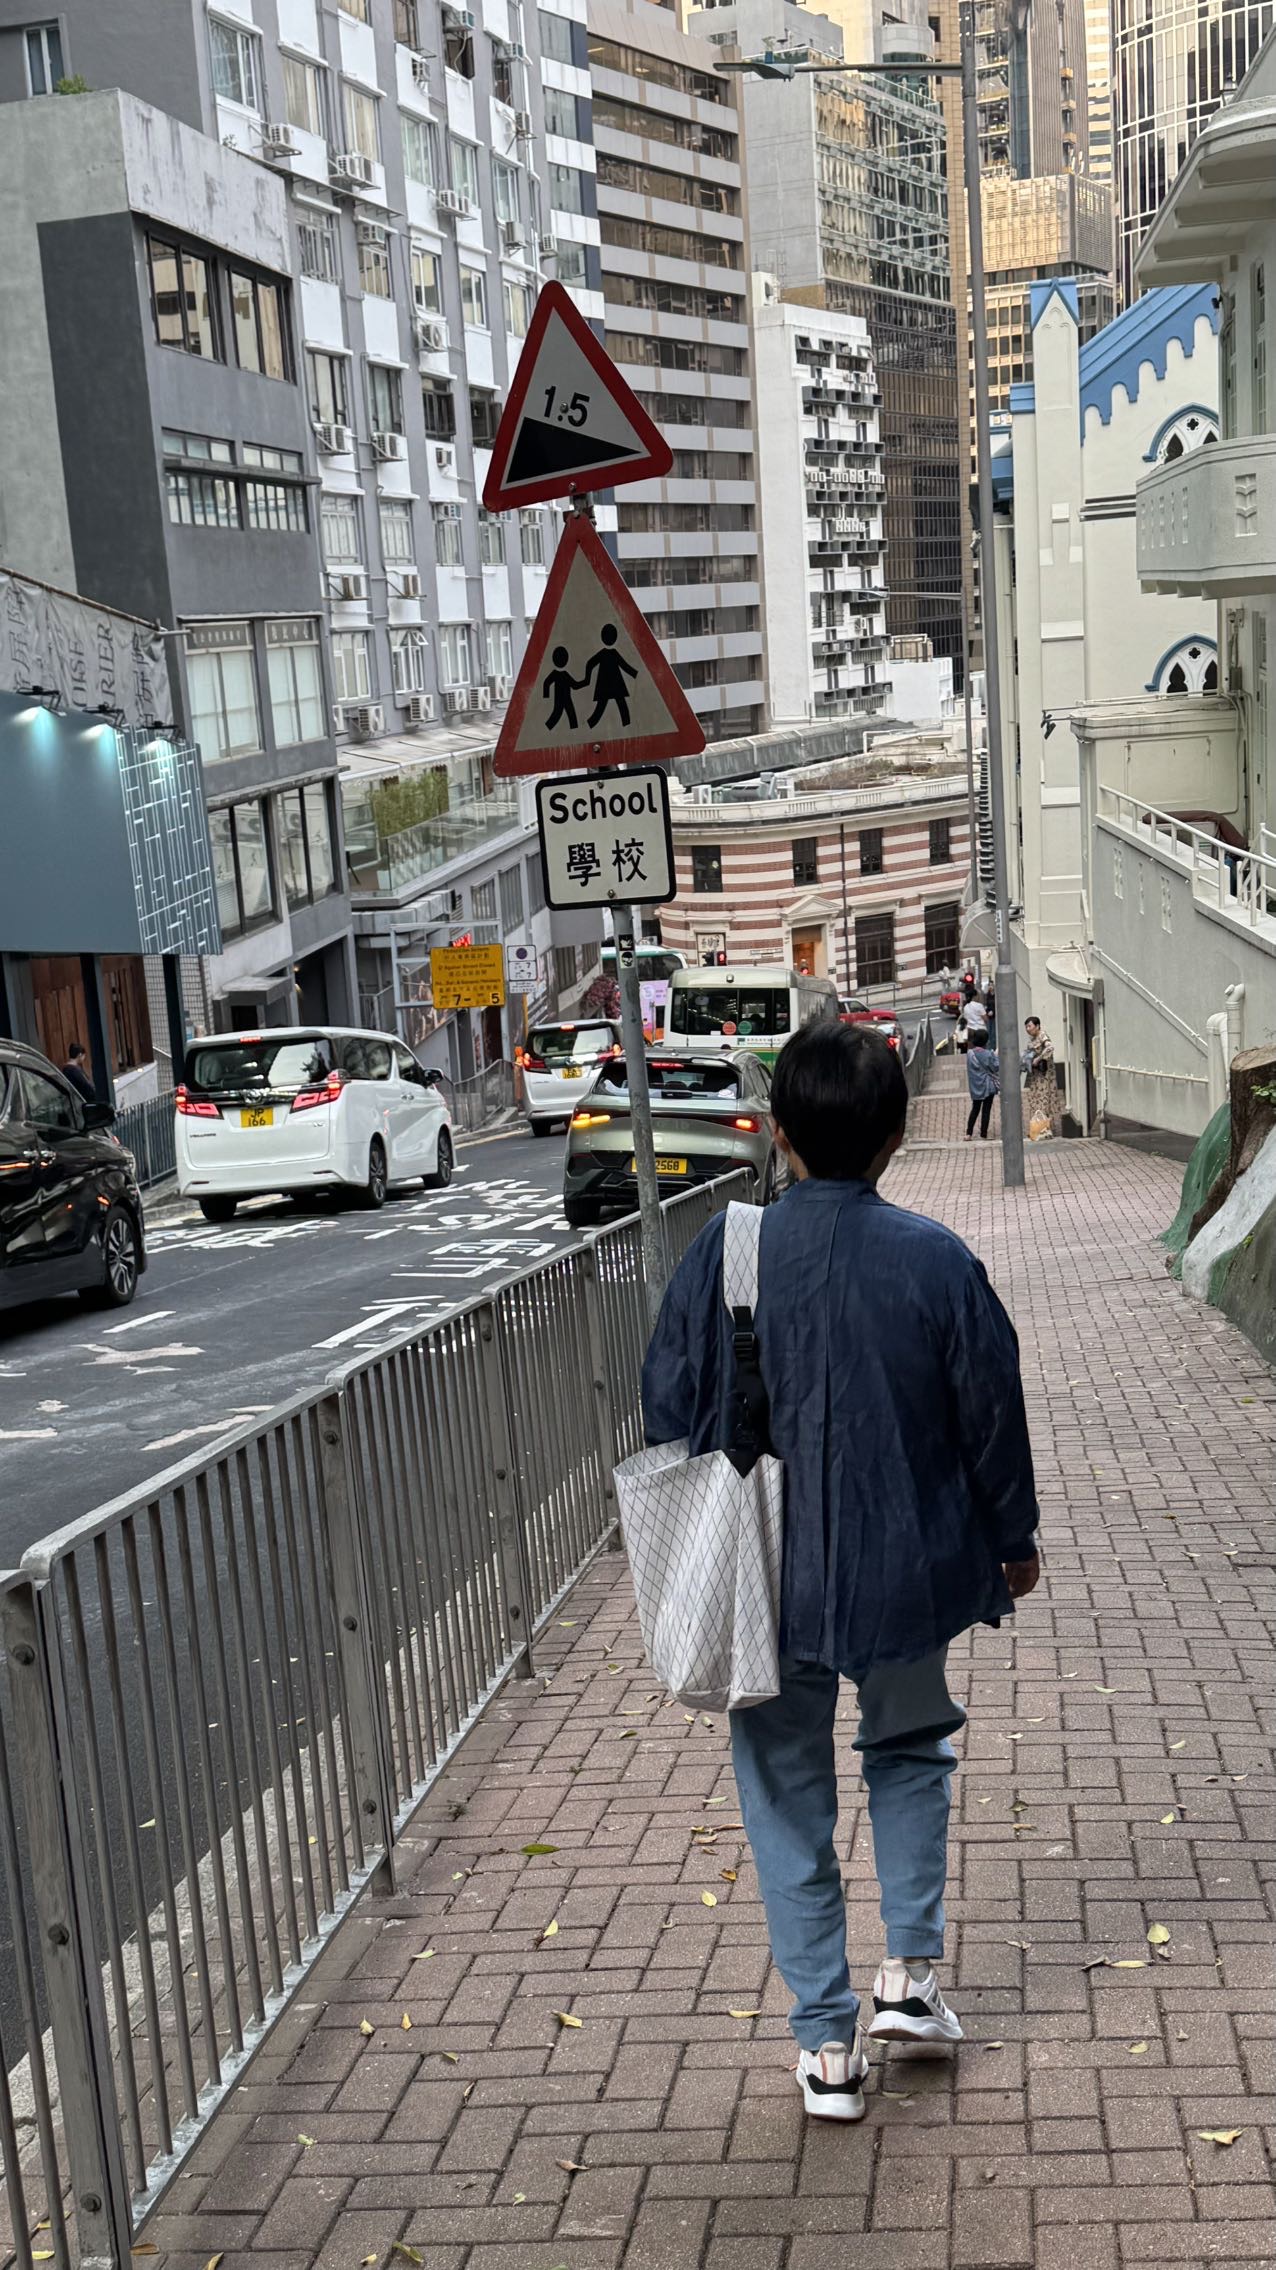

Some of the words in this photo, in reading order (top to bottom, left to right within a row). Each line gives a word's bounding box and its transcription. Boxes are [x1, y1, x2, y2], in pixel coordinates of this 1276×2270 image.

[549, 783, 658, 824] School
[566, 838, 648, 887] 學校
[491, 993, 500, 1004] 5
[248, 1117, 266, 1127] 166
